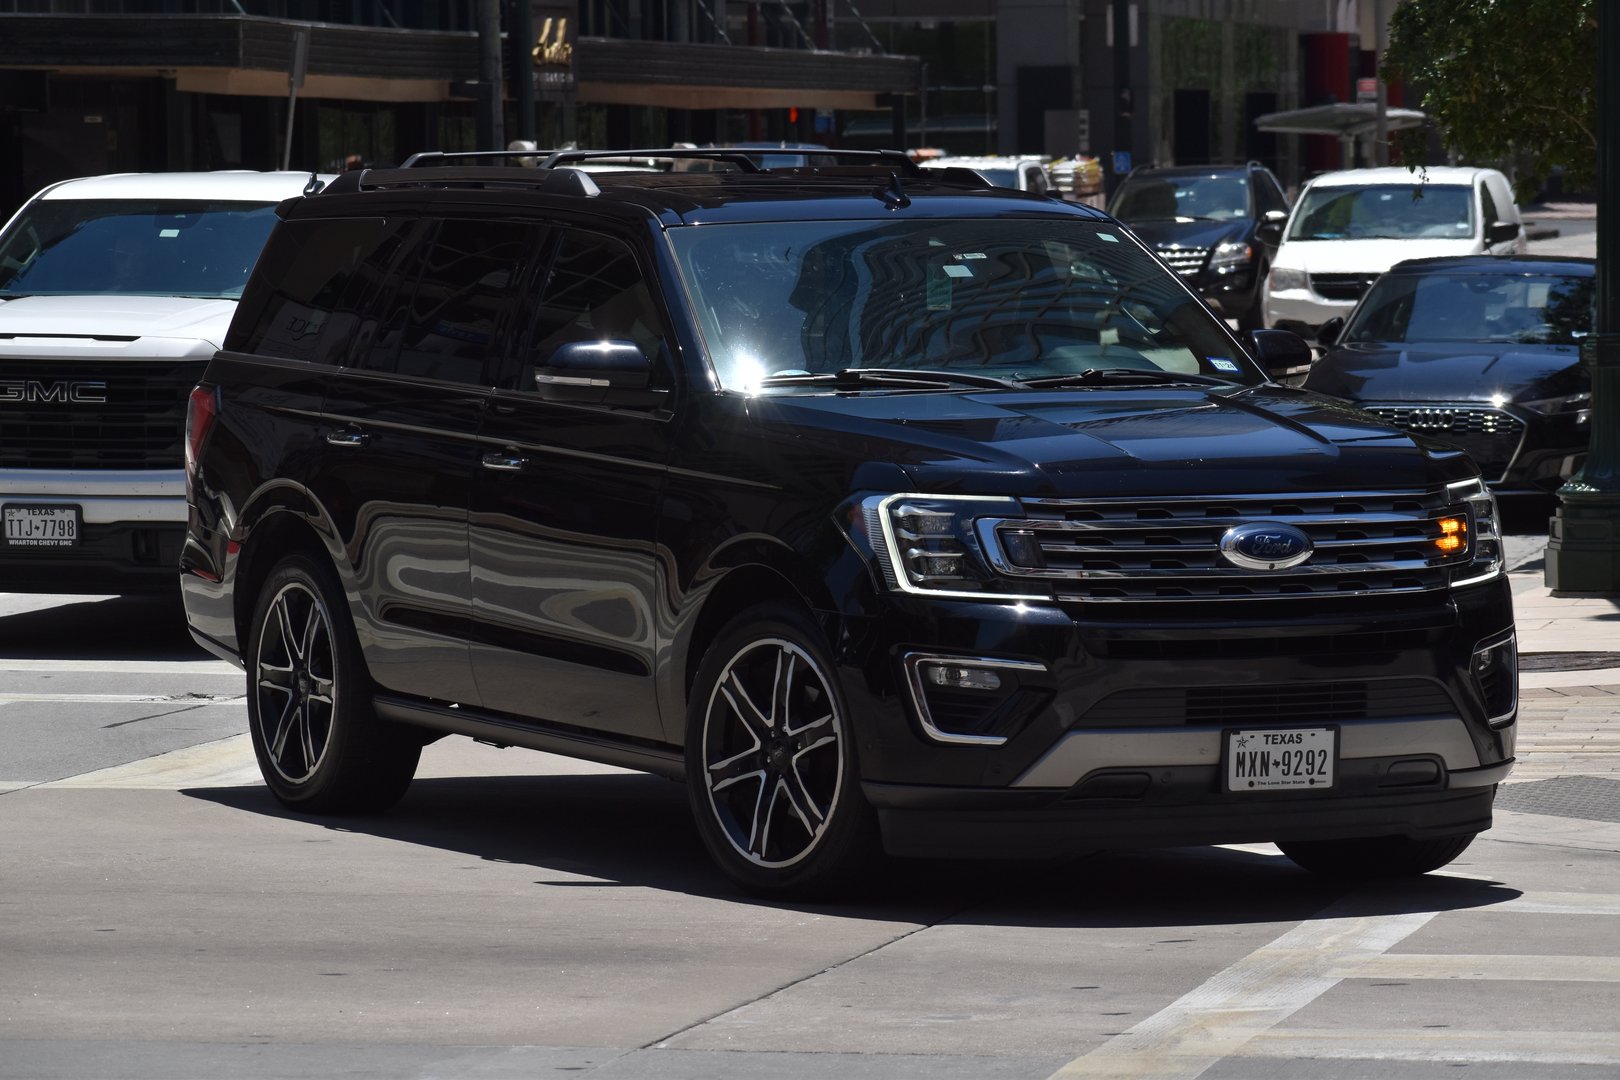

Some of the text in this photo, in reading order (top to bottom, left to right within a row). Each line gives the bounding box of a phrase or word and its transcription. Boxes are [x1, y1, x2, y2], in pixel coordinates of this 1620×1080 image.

[0, 380, 106, 403] GMC
[27, 508, 55, 516] TEXAS
[1251, 535, 1292, 555] Ford
[1263, 733, 1303, 745] TEXAS
